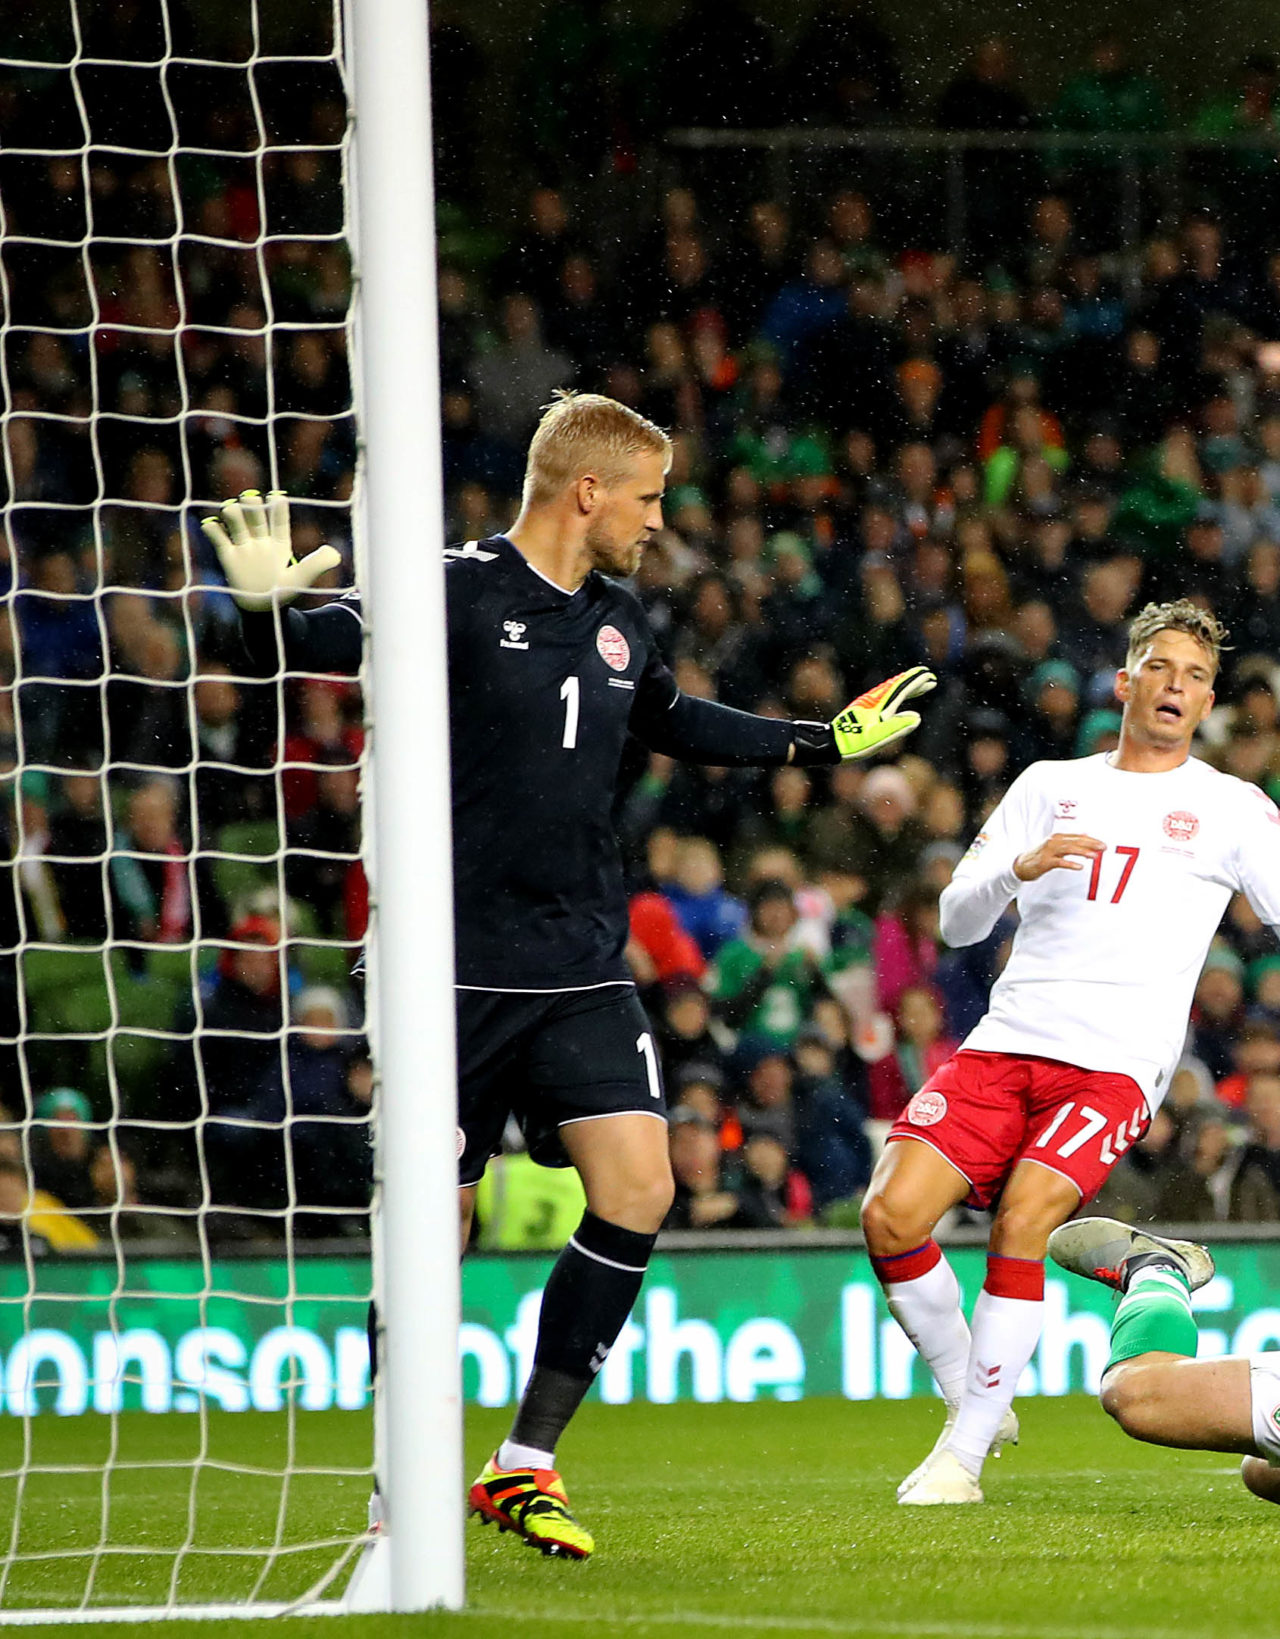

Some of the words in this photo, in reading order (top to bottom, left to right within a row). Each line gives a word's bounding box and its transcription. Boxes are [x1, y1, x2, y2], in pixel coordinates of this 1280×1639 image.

[559, 675, 580, 749] 1
[1086, 845, 1140, 904] 17
[635, 1032, 661, 1099] 1
[1035, 1101, 1108, 1158] 17
[0, 1326, 373, 1416] onsor
[841, 1282, 1112, 1400] Irh
